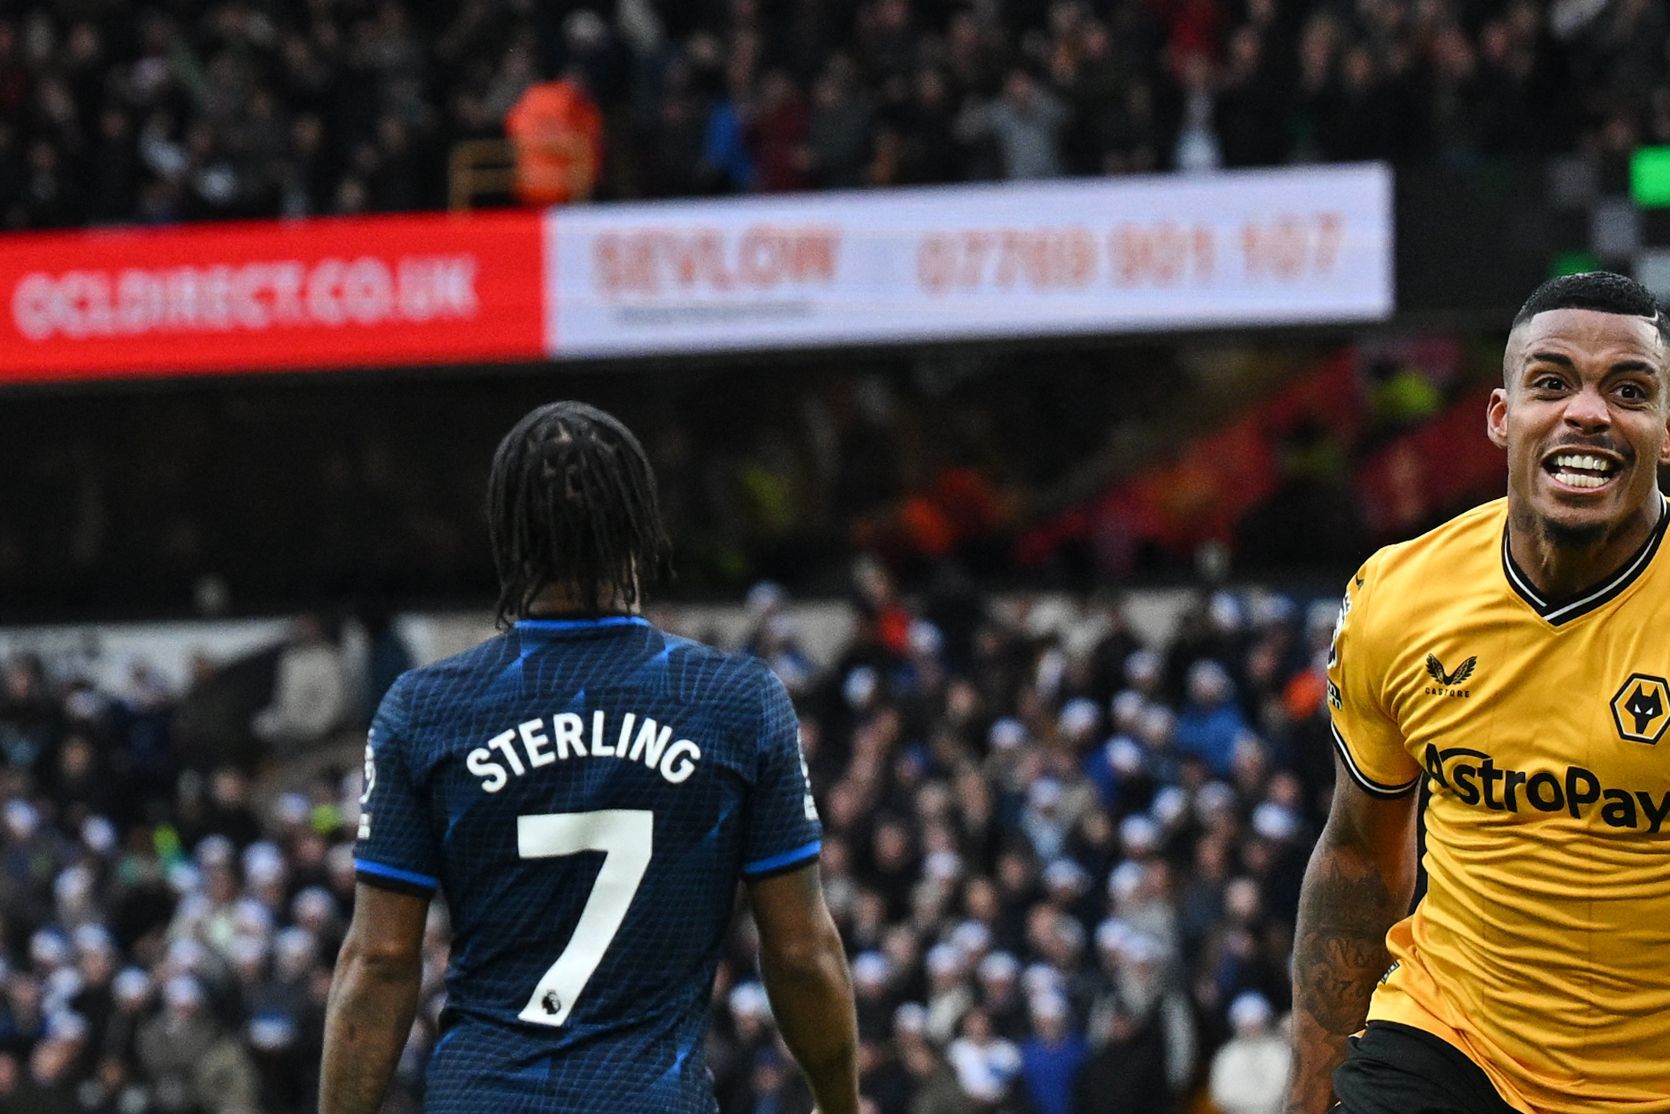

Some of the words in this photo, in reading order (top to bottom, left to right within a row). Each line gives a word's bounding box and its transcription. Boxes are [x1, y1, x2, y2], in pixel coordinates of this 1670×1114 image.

[12, 250, 482, 341] OCLDIRECT.CO.UK
[466, 710, 701, 793] STERLING
[516, 808, 654, 1027] 7
